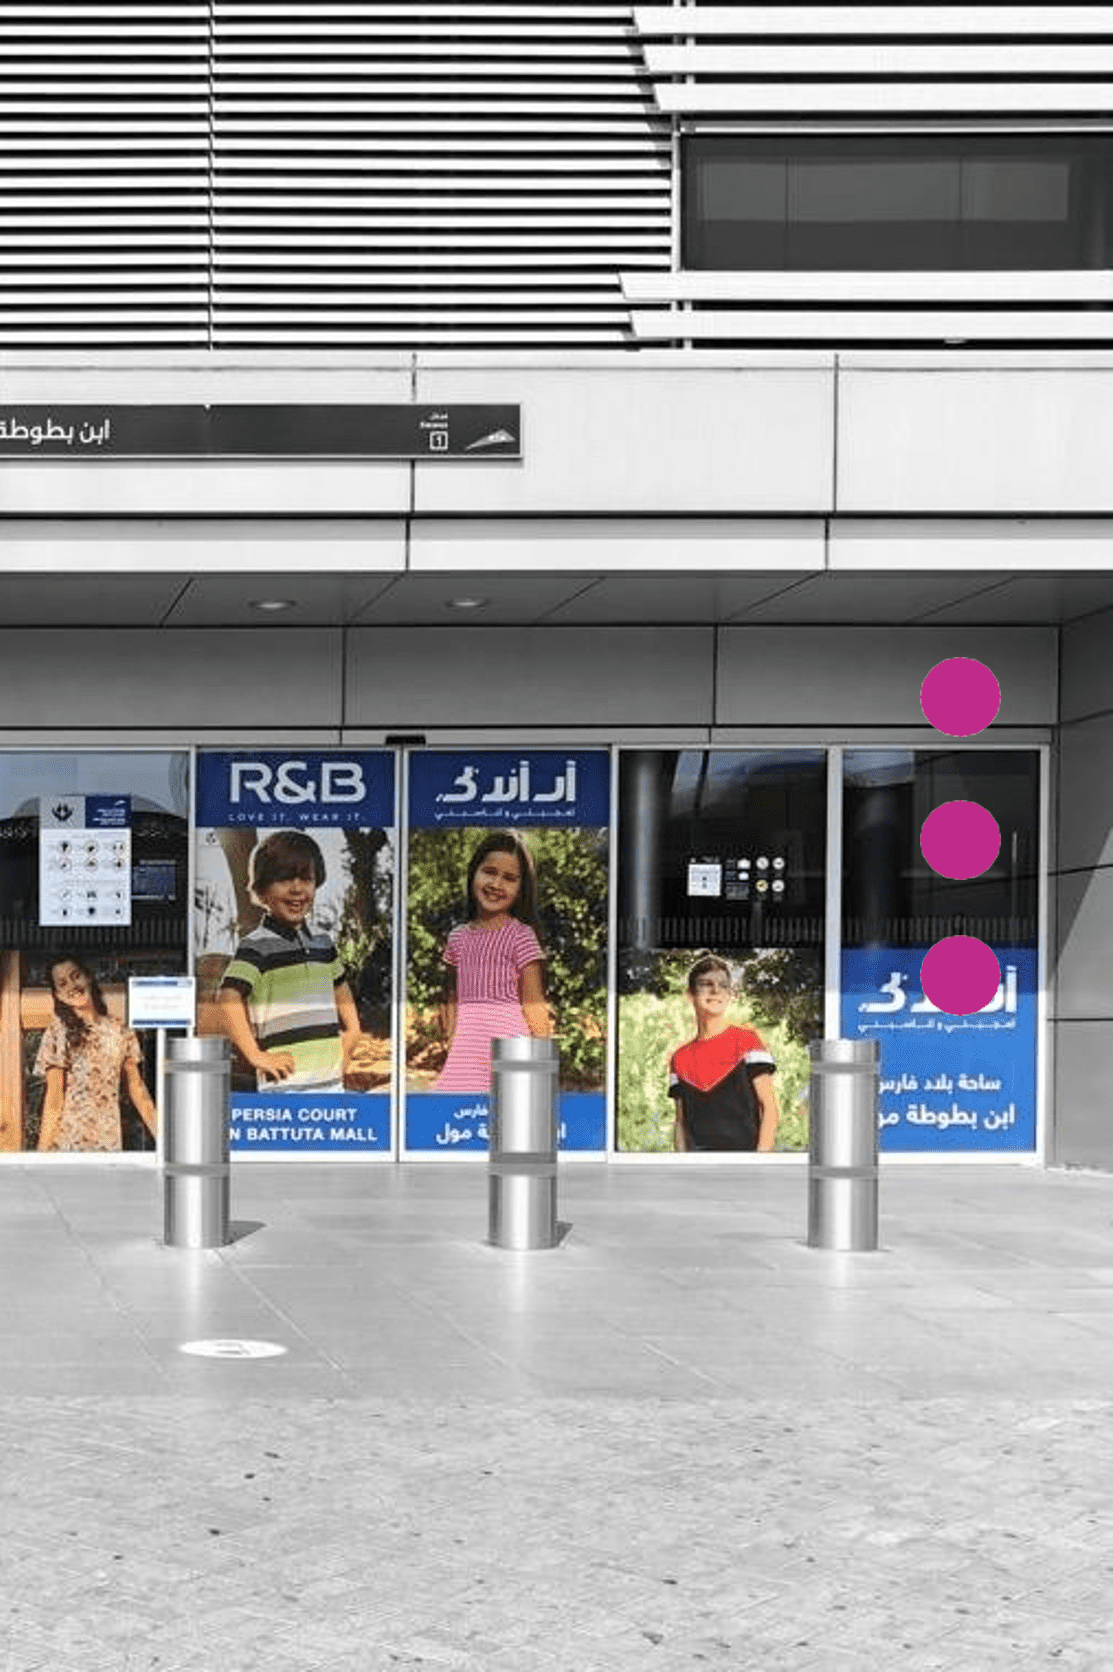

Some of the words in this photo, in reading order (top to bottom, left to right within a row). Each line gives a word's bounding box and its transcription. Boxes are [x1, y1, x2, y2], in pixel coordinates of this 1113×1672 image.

[79, 418, 110, 445] ابن
[230, 761, 367, 804] R&B
[231, 1108, 293, 1122] PERSIA
[297, 1108, 358, 1122] COURT
[906, 1102, 977, 1130] بطوطة
[983, 1102, 1016, 1130] ابن
[246, 1127, 325, 1142] BATTUTA
[330, 1127, 378, 1142] MALL
[435, 1122, 473, 1144] مول
